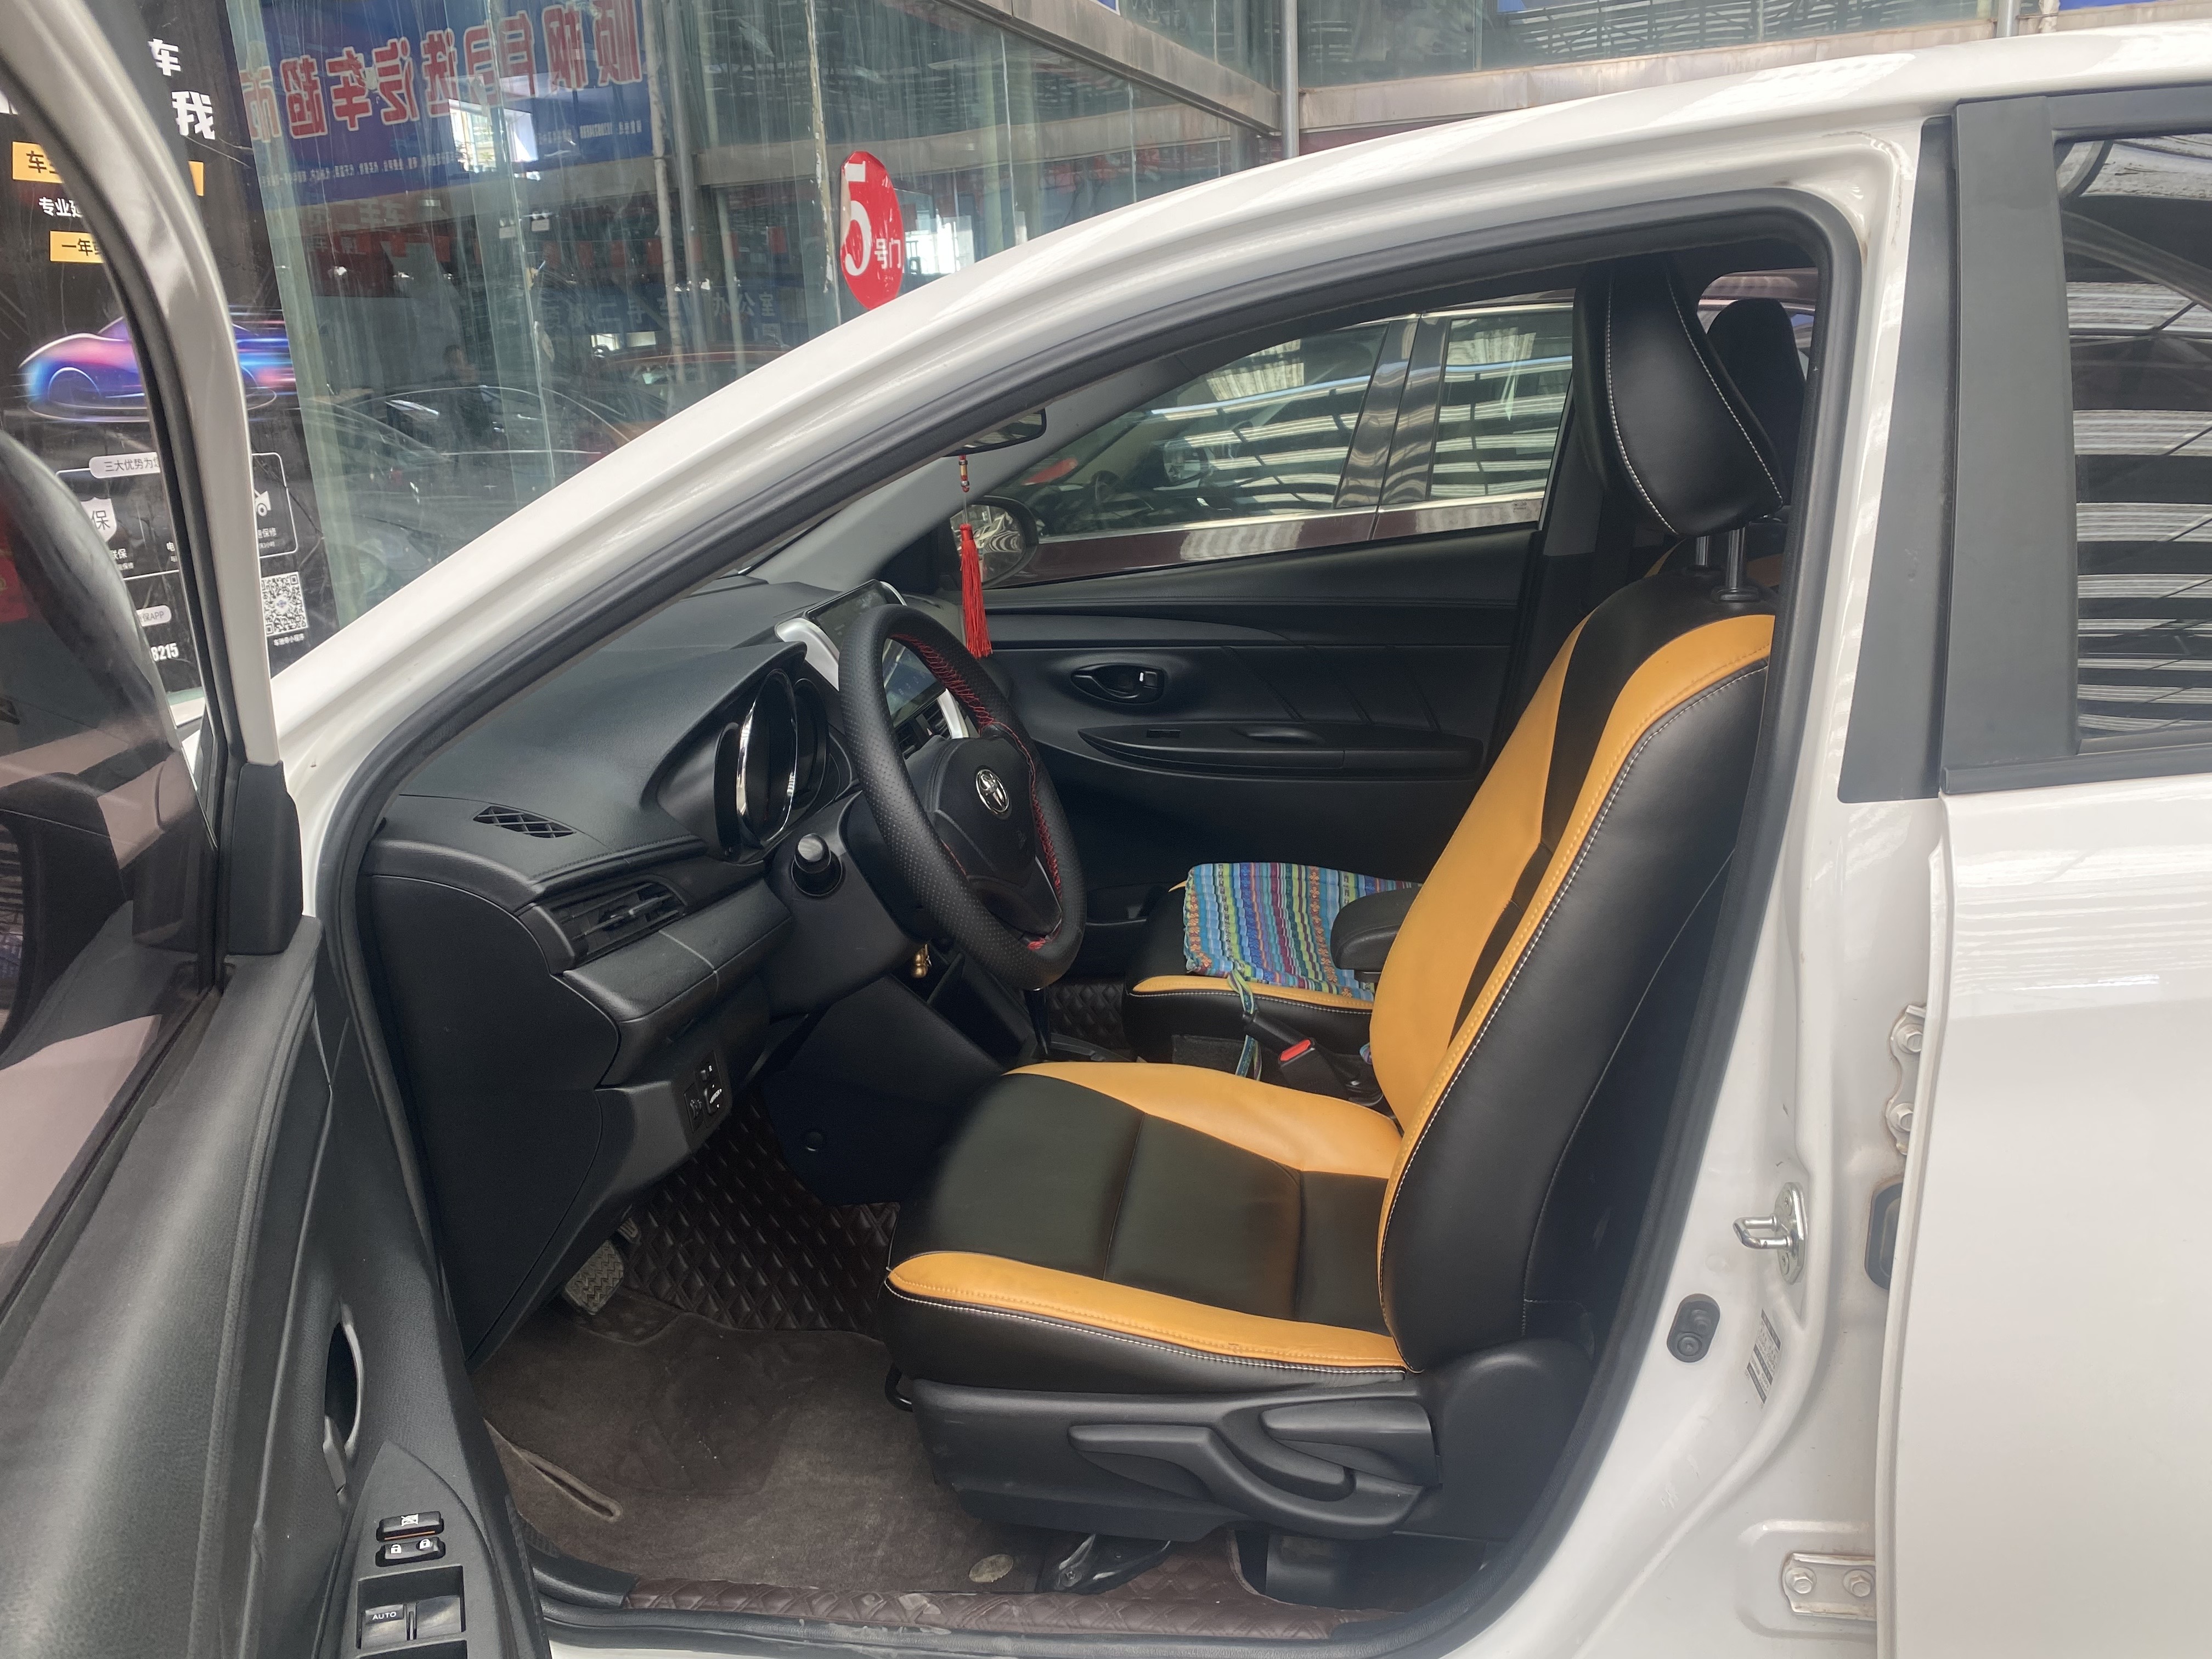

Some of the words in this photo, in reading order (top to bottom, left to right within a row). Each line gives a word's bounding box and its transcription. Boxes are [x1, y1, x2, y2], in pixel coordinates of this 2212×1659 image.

[148, 38, 182, 76] 车
[171, 91, 216, 140] 我
[874, 238, 902, 270] 号门
[91, 510, 111, 531] 保
[373, 1611, 397, 1620] AUTO
